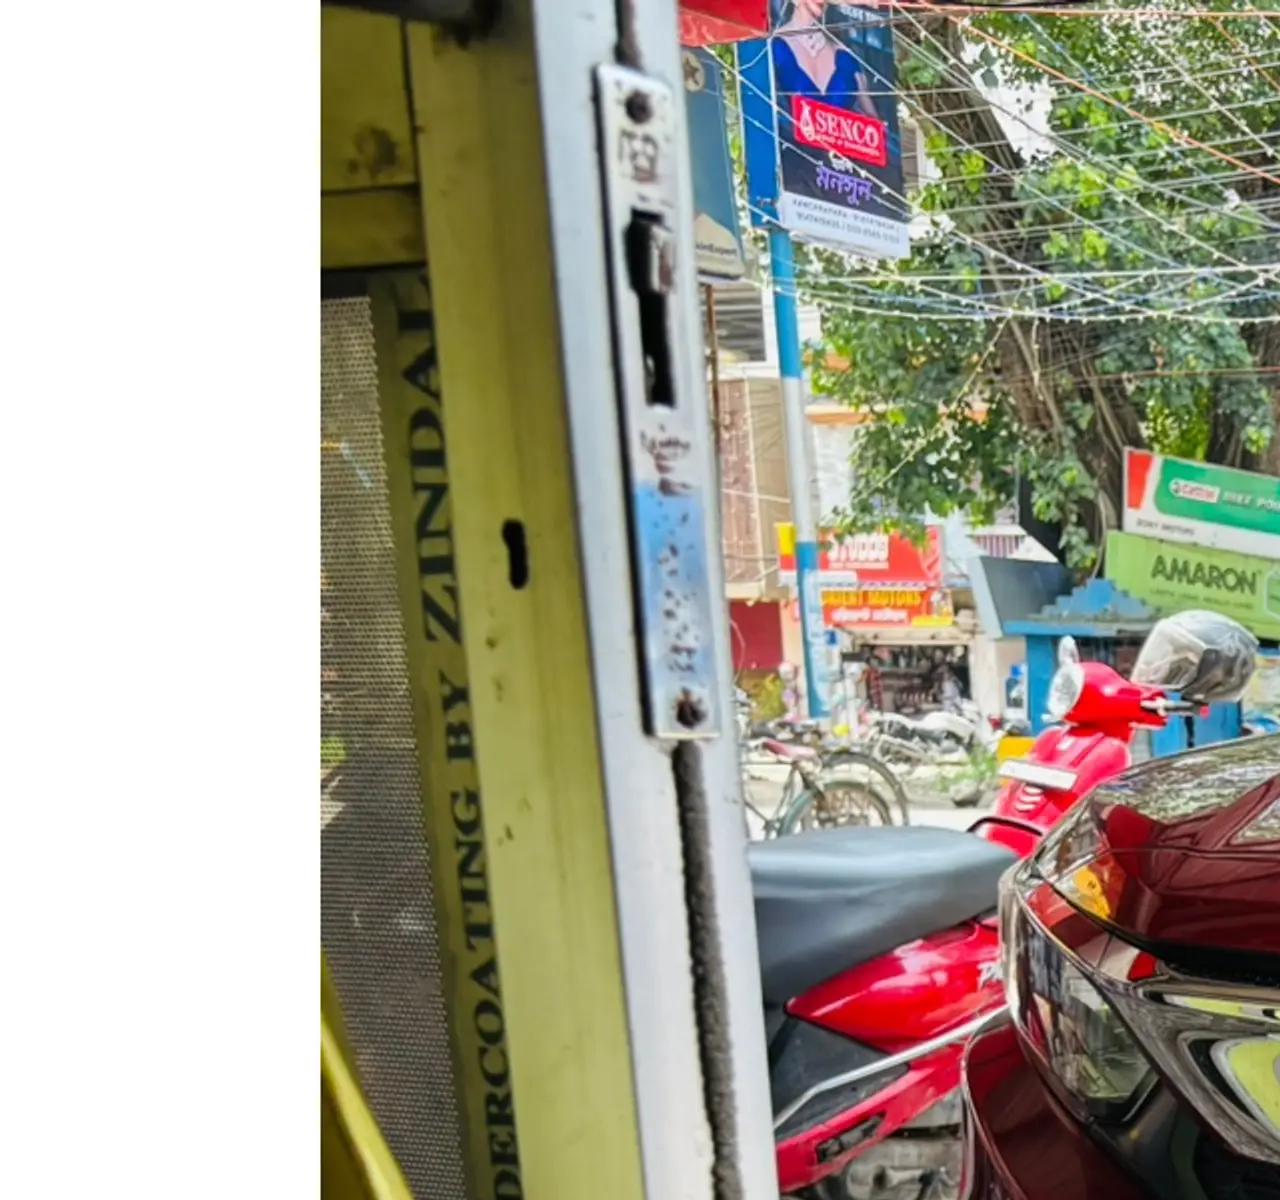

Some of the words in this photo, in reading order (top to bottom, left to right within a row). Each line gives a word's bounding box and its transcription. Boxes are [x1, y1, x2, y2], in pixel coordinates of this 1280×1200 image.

[814, 109, 879, 147] SENCO
[1151, 554, 1257, 596] AMARON
[437, 669, 476, 763] BY
